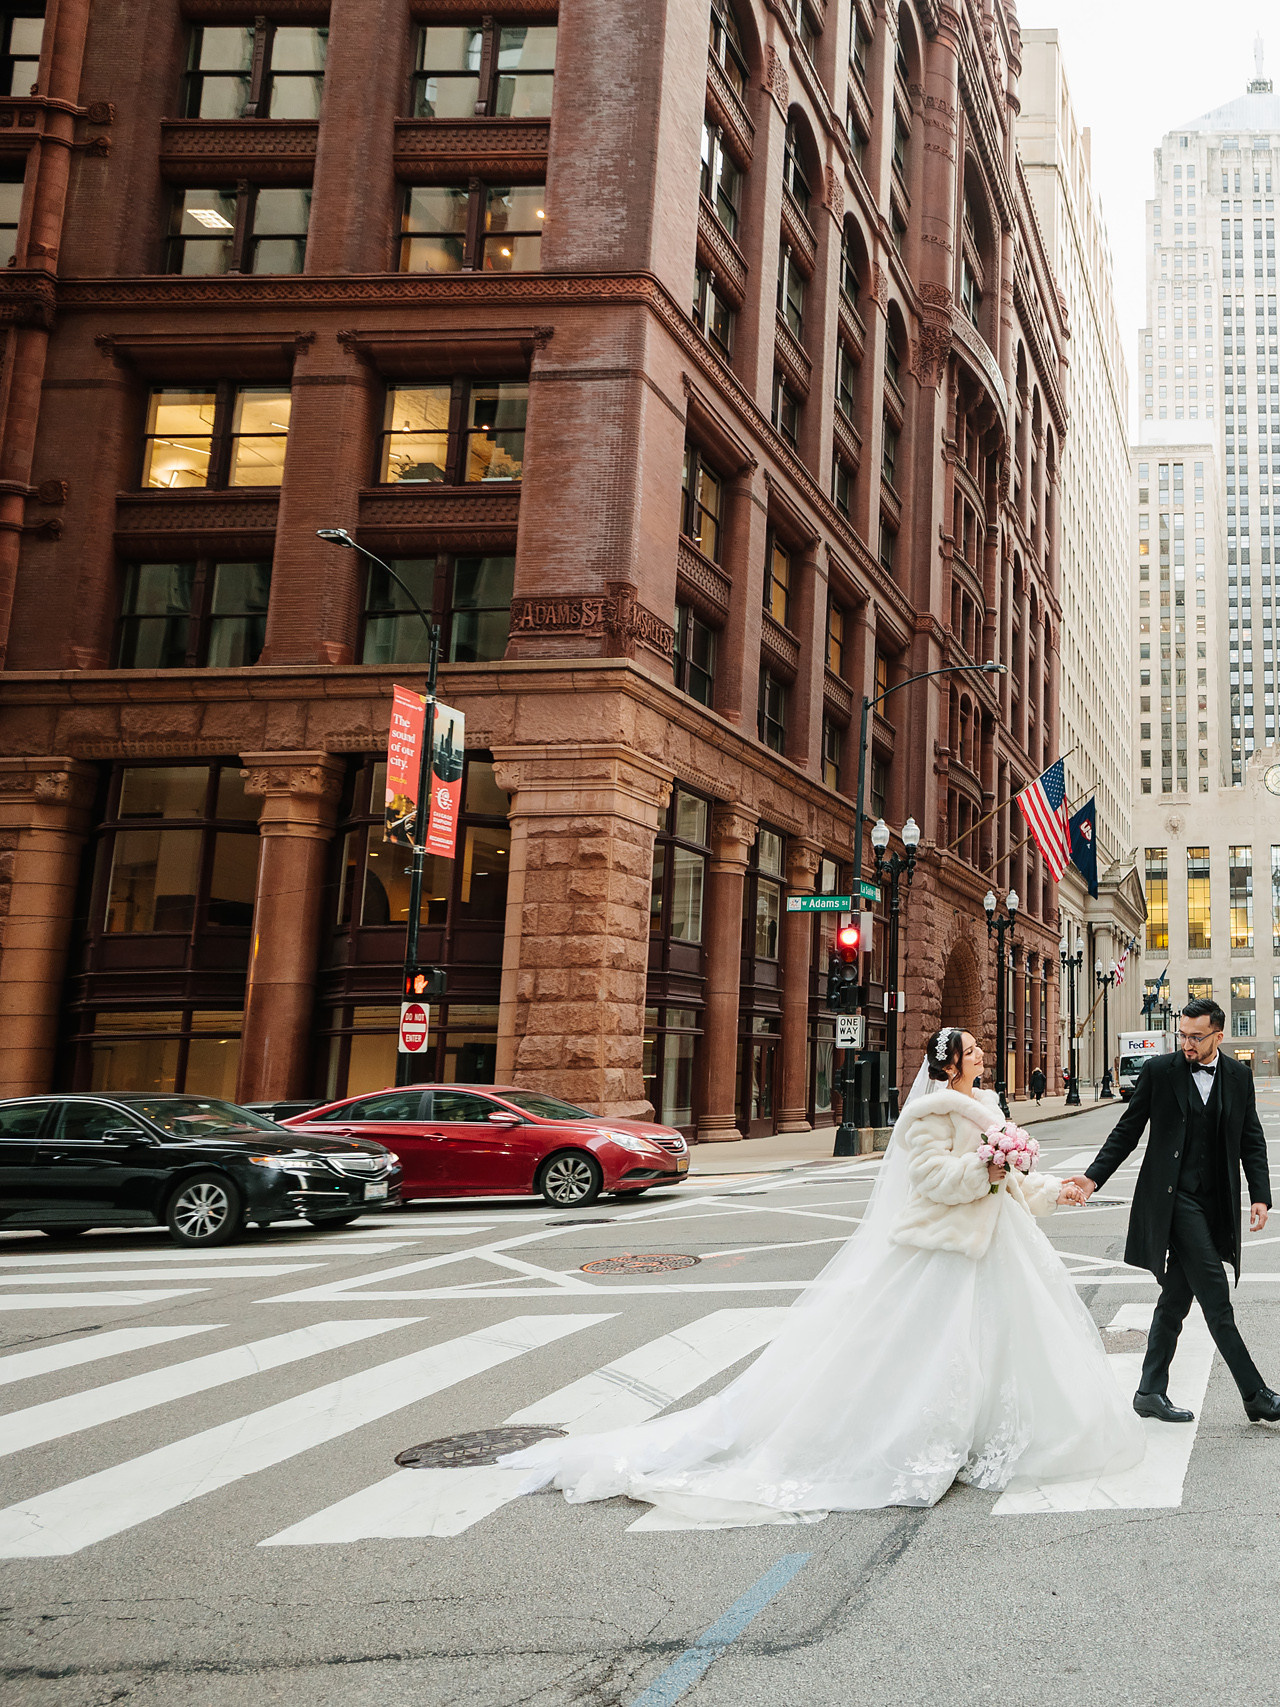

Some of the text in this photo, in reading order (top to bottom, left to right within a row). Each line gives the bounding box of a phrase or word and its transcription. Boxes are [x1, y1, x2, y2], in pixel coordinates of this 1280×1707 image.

[520, 601, 581, 628] ADAMS
[393, 713, 411, 728] The
[391, 729, 416, 744] sound
[391, 742, 415, 757] of our
[390, 755, 408, 770] city.
[809, 899, 840, 908] Adams
[414, 1013, 424, 1021] NOT
[840, 1018, 858, 1026] ONE
[840, 1027, 858, 1035] WAY
[405, 1034, 422, 1042] ENTER
[1128, 1040, 1155, 1049] FedEx
